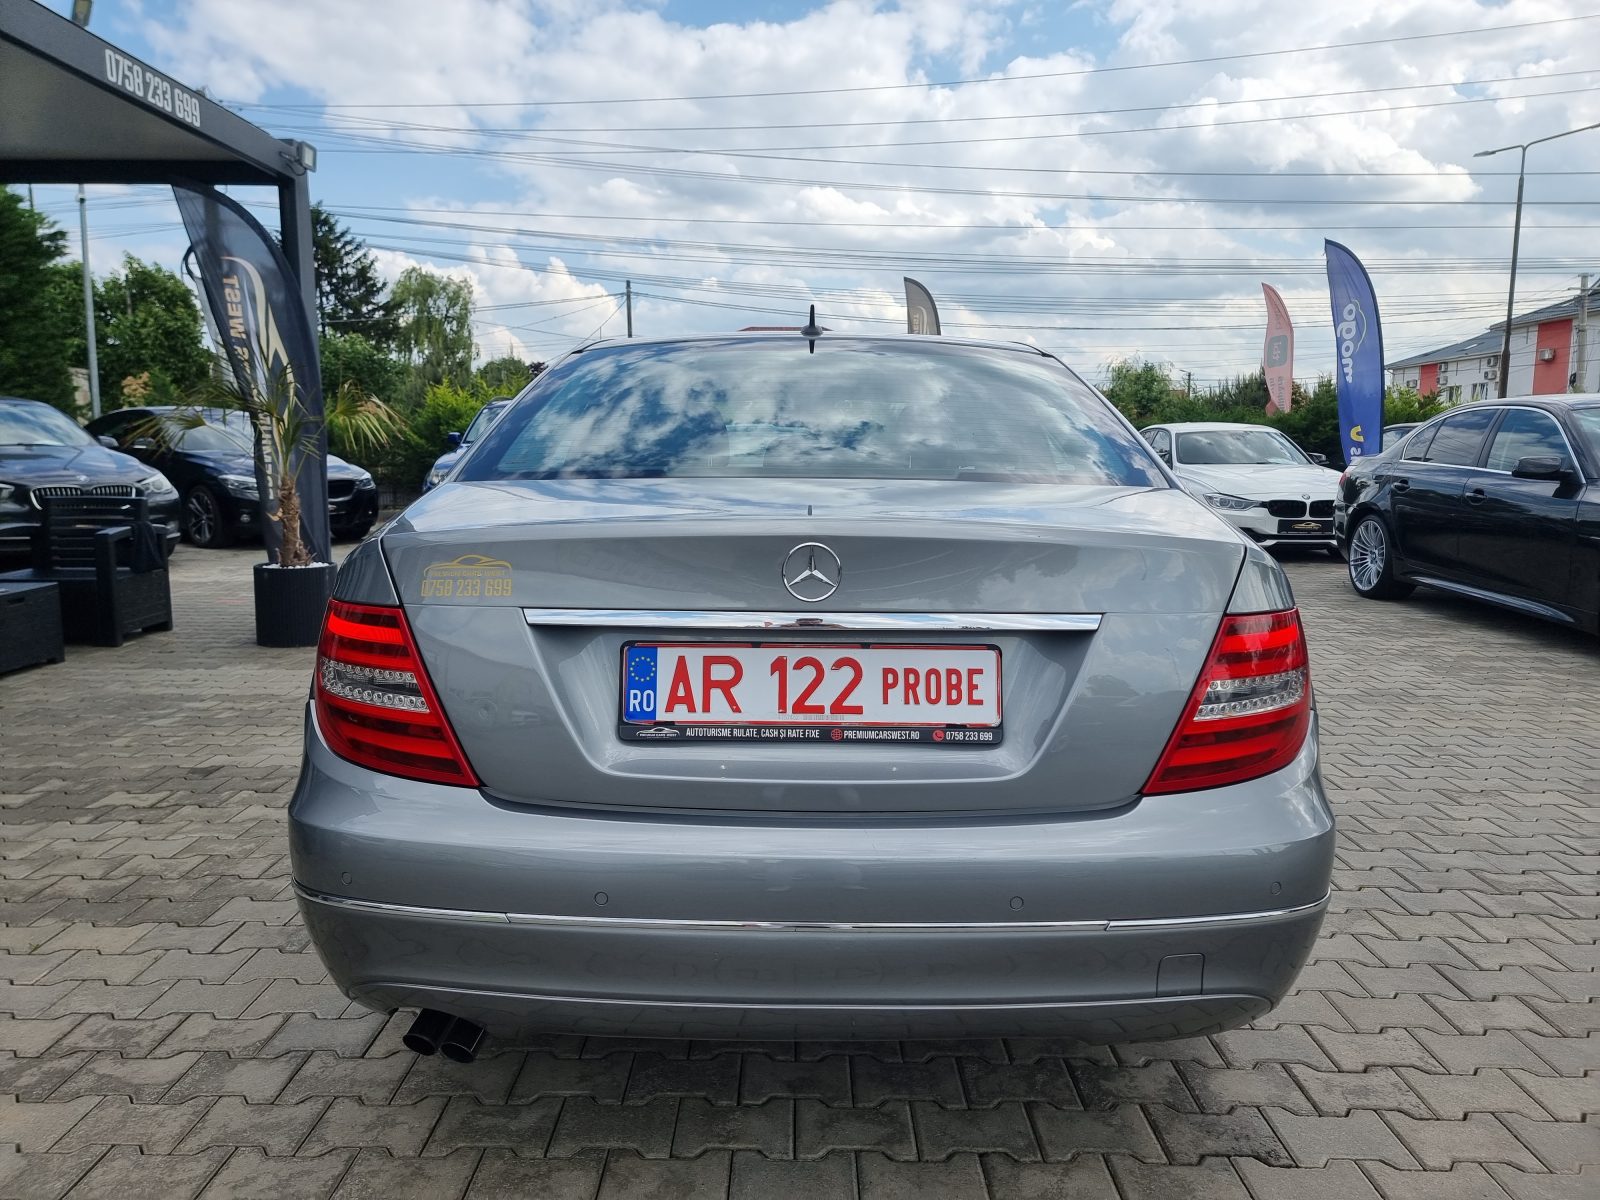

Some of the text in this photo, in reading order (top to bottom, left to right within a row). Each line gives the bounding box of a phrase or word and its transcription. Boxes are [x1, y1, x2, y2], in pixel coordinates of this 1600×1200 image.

[105, 49, 201, 128] 0758 233 699
[421, 578, 513, 597] 0758 233 699
[665, 655, 984, 715] AR 122 PROBE
[629, 689, 655, 712] RO
[686, 728, 731, 737] AUTOTURISME
[733, 728, 760, 738] RULATE,
[761, 728, 779, 738] CASH
[788, 729, 804, 738] RATE
[805, 729, 820, 738] FIXE
[843, 730, 920, 740] PREMIUMCARSWEST.RO
[946, 731, 993, 741] 0758 233 699
